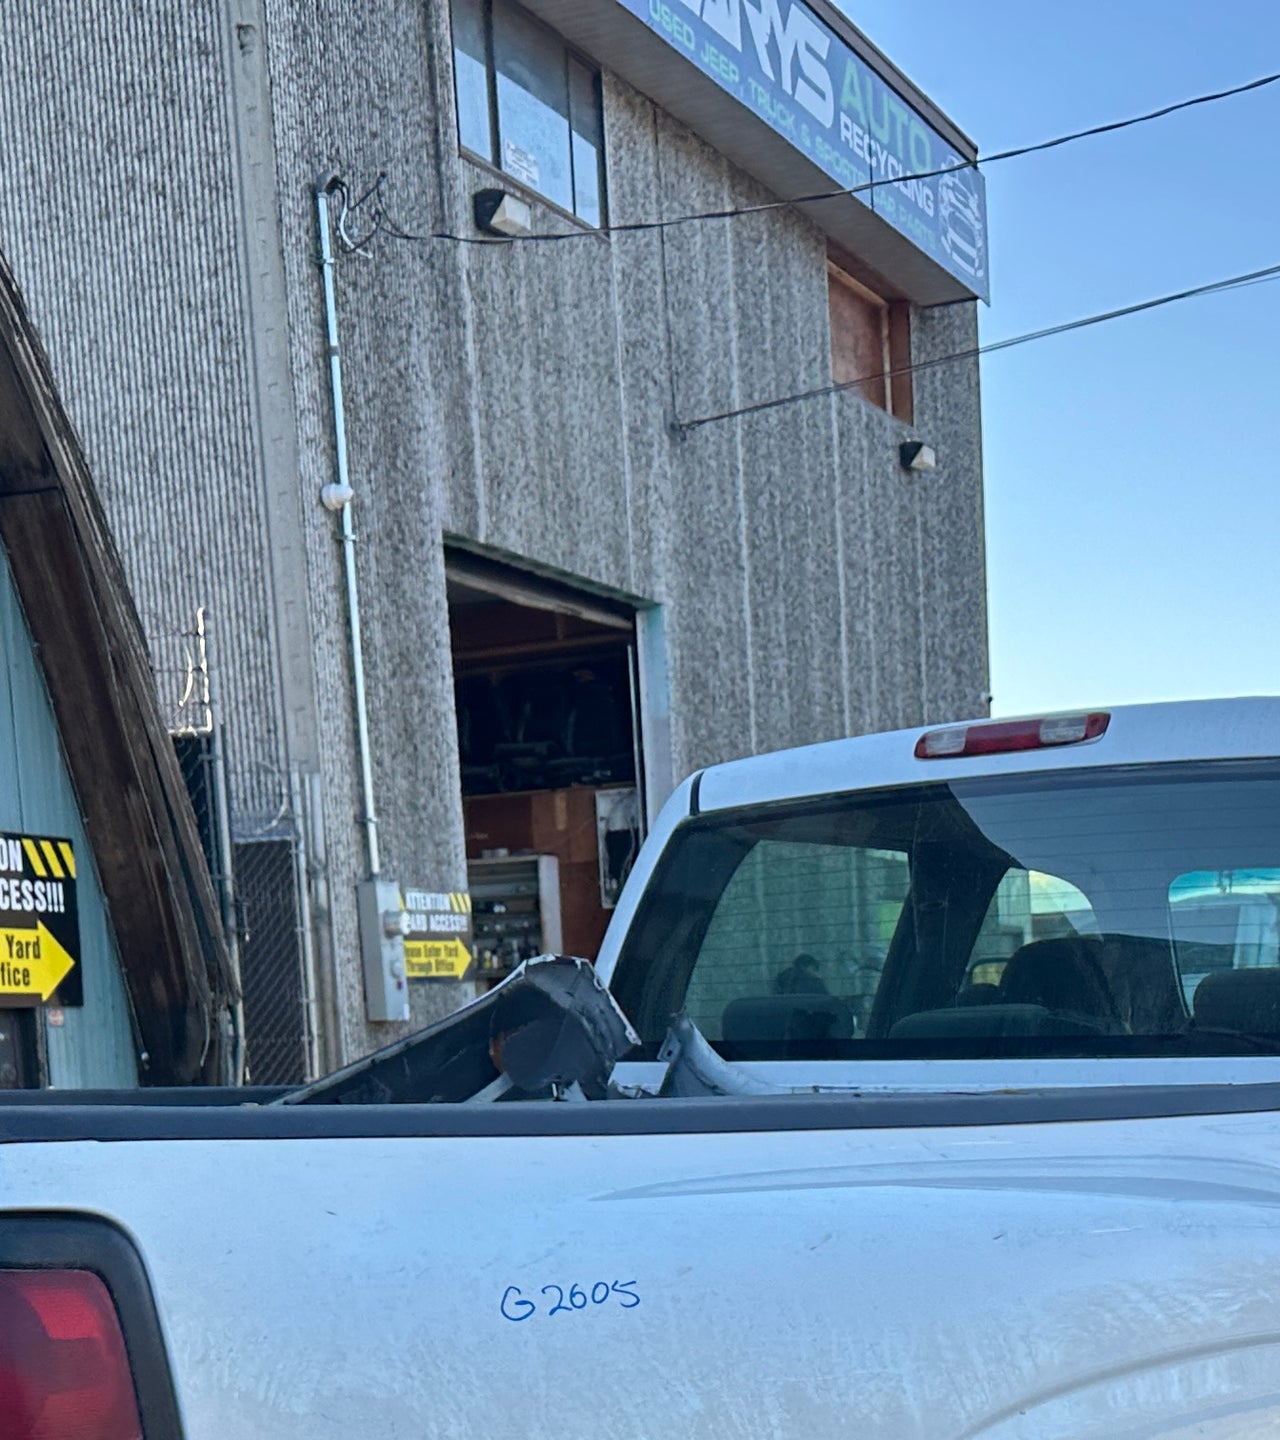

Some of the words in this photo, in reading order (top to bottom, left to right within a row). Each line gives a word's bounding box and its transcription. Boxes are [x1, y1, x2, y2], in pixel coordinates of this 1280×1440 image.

[649, 0, 696, 50] USED
[748, 76, 796, 135] TRUCK
[840, 58, 932, 176] AUTO
[840, 110, 935, 218] RECYCLING
[5, 935, 41, 961] Yard
[500, 1280, 641, 1322] G2605
